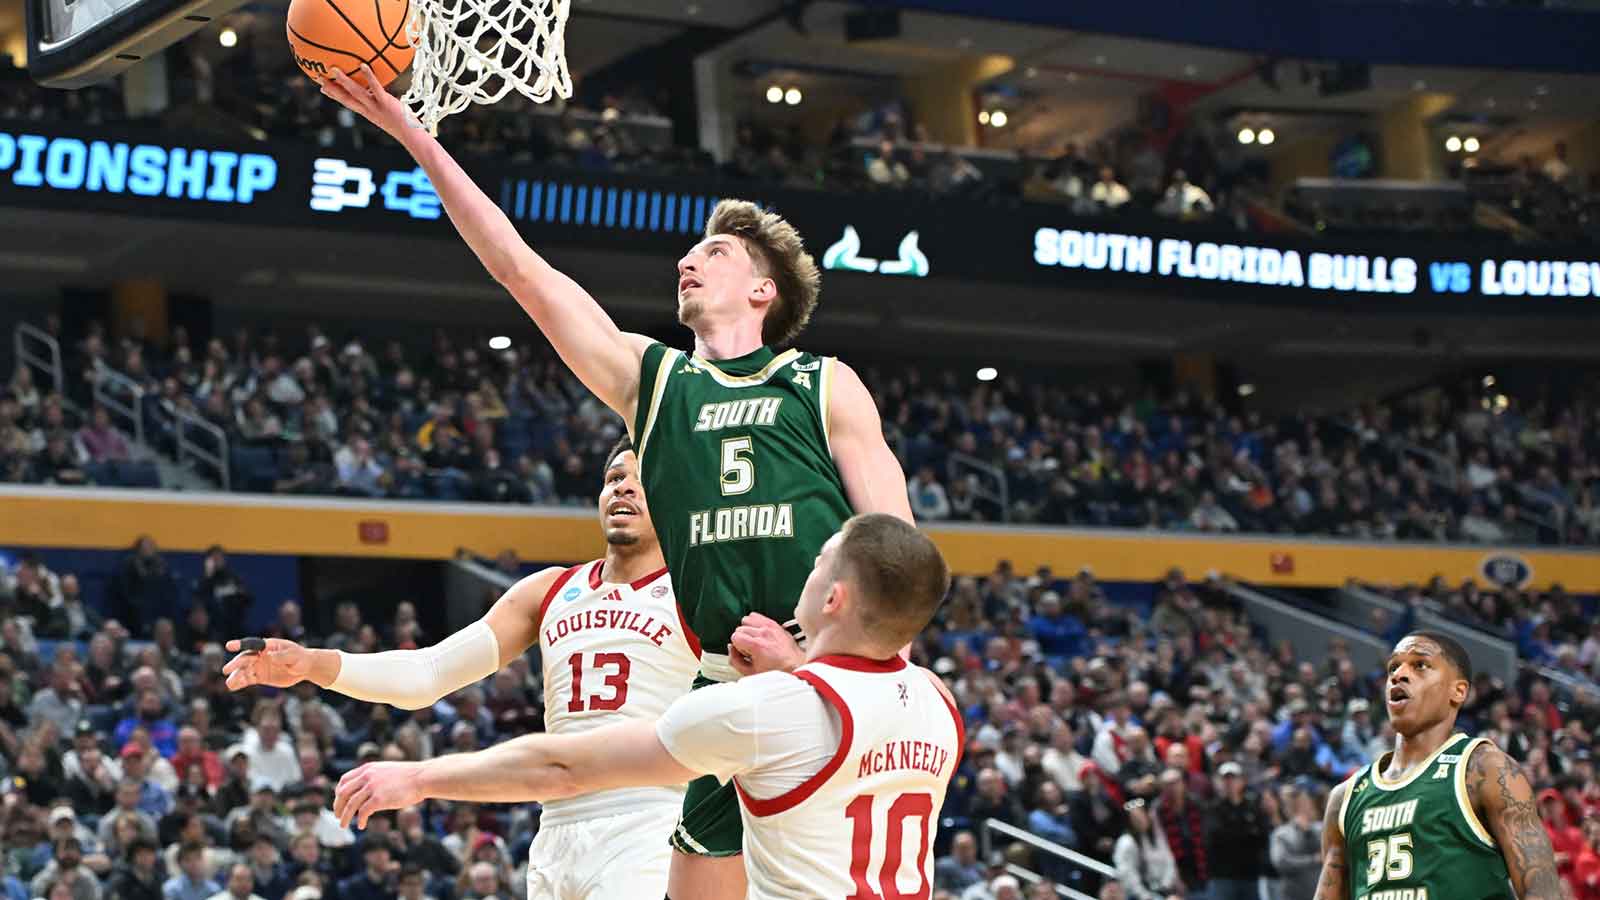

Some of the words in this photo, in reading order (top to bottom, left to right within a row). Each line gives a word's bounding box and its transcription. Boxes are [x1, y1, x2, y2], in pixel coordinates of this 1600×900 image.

[1034, 227, 1153, 274] SOUTH
[1157, 238, 1305, 288] FLORIDA
[1308, 252, 1418, 294] BULLS
[694, 397, 784, 432] SOUTH
[720, 436, 755, 496] 5
[689, 503, 794, 548] FLORIDA
[545, 609, 673, 647] LOUISVILLE
[567, 652, 632, 713] 13
[1361, 798, 1420, 836] SOUTH
[845, 792, 933, 900] 10
[1366, 832, 1414, 888] 35
